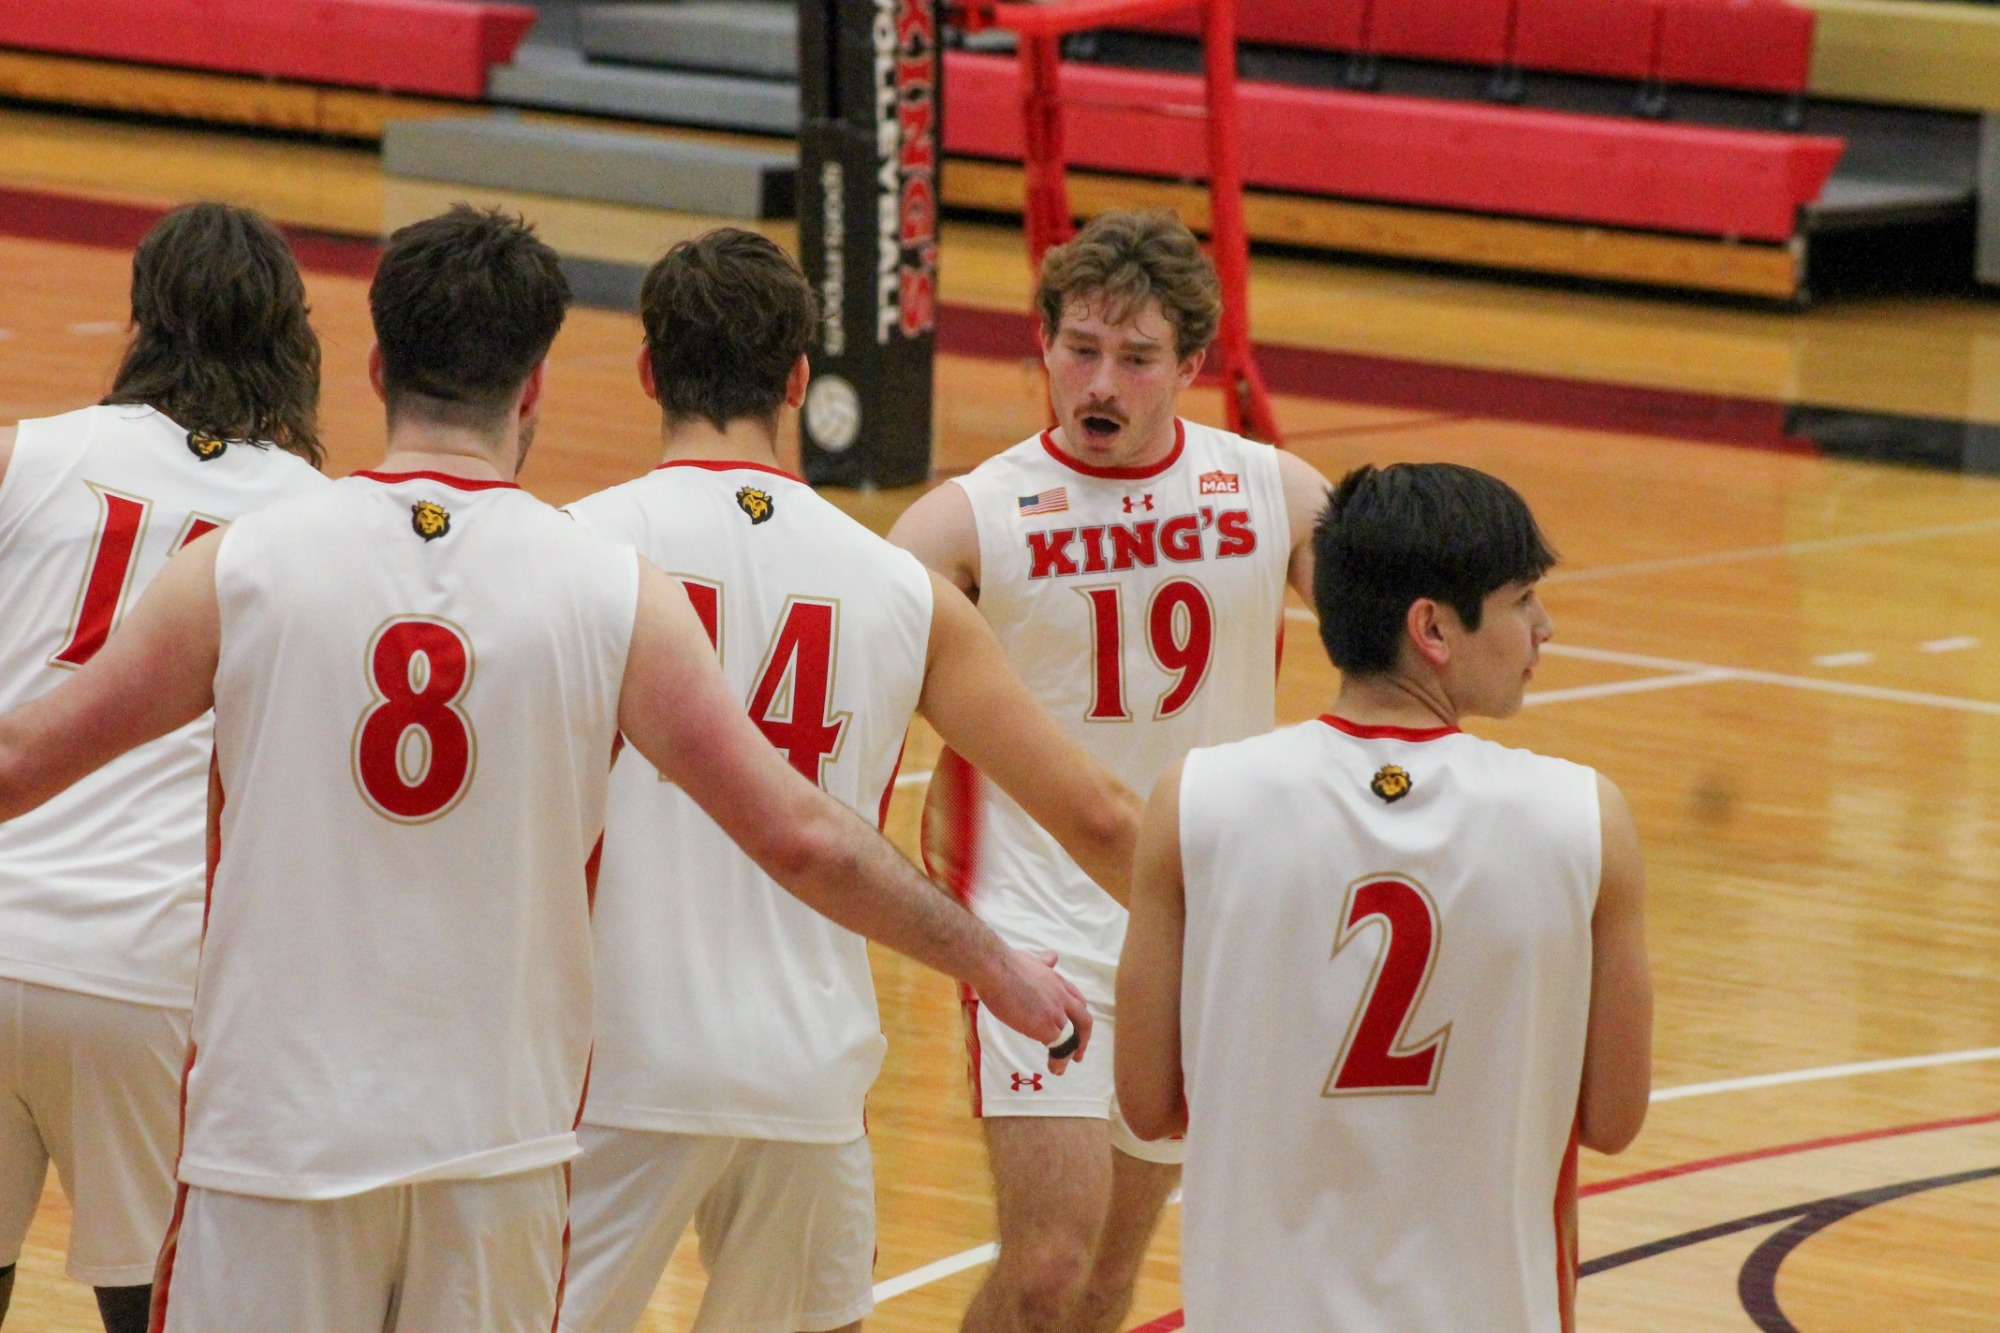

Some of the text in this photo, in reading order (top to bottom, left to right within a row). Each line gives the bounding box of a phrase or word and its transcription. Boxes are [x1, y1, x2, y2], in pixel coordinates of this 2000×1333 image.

[1026, 505, 1257, 580] KING'S
[1201, 480, 1237, 493] MAC
[47, 479, 231, 671] 1
[1070, 575, 1217, 723] 19
[350, 613, 478, 826] 8
[1321, 871, 1453, 1098] 2
